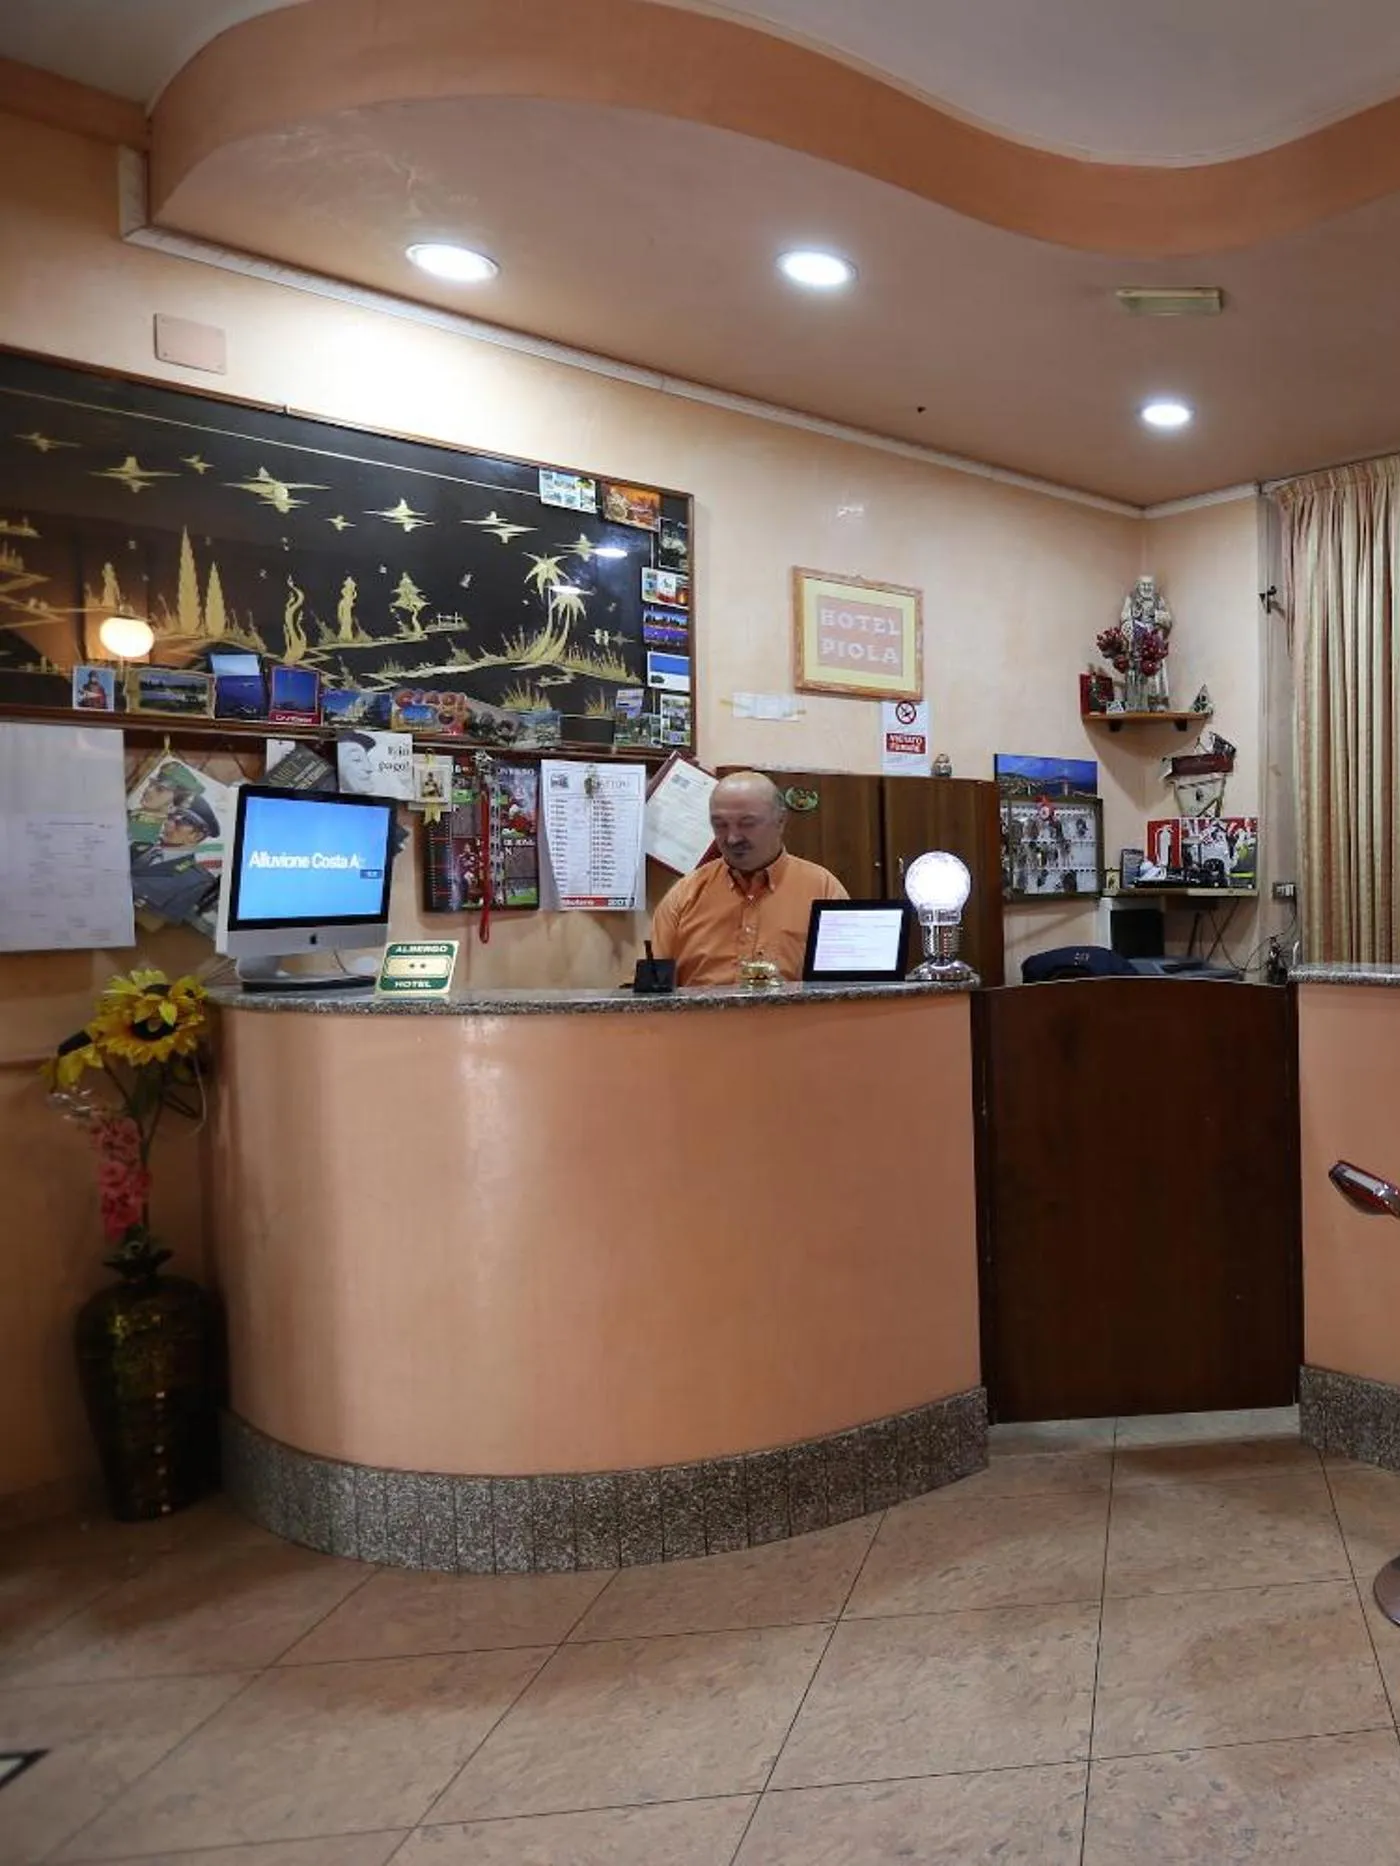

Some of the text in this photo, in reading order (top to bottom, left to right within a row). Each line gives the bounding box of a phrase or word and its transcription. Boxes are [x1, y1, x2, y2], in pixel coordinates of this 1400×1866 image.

[820, 608, 901, 635] HOTEL
[821, 637, 897, 663] PIOLA
[249, 851, 310, 868] Alluvione
[311, 853, 348, 869] Costa
[395, 945, 449, 953] ALBERGO
[394, 980, 431, 988] HOTEL
